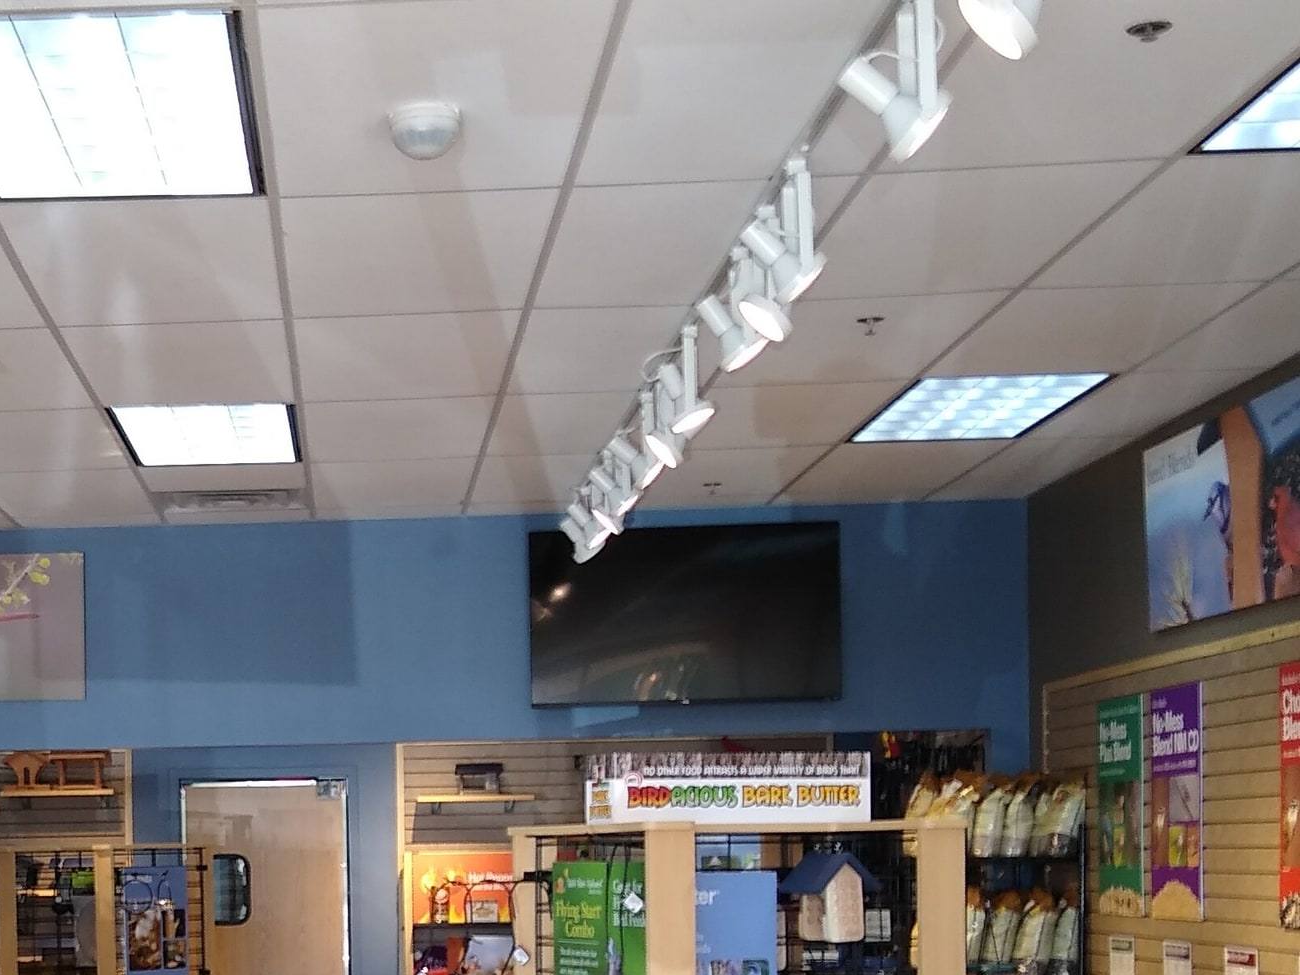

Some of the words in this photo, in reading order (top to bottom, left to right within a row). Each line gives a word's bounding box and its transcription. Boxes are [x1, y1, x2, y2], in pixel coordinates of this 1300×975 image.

[1152, 709, 1185, 735] No-Mess
[1152, 732, 1173, 757] Blend
[680, 766, 702, 776] FOOD
[742, 784, 793, 809] BARK
[797, 784, 861, 809] BUTTER
[555, 899, 580, 923] Flying
[565, 920, 595, 939] Combo
